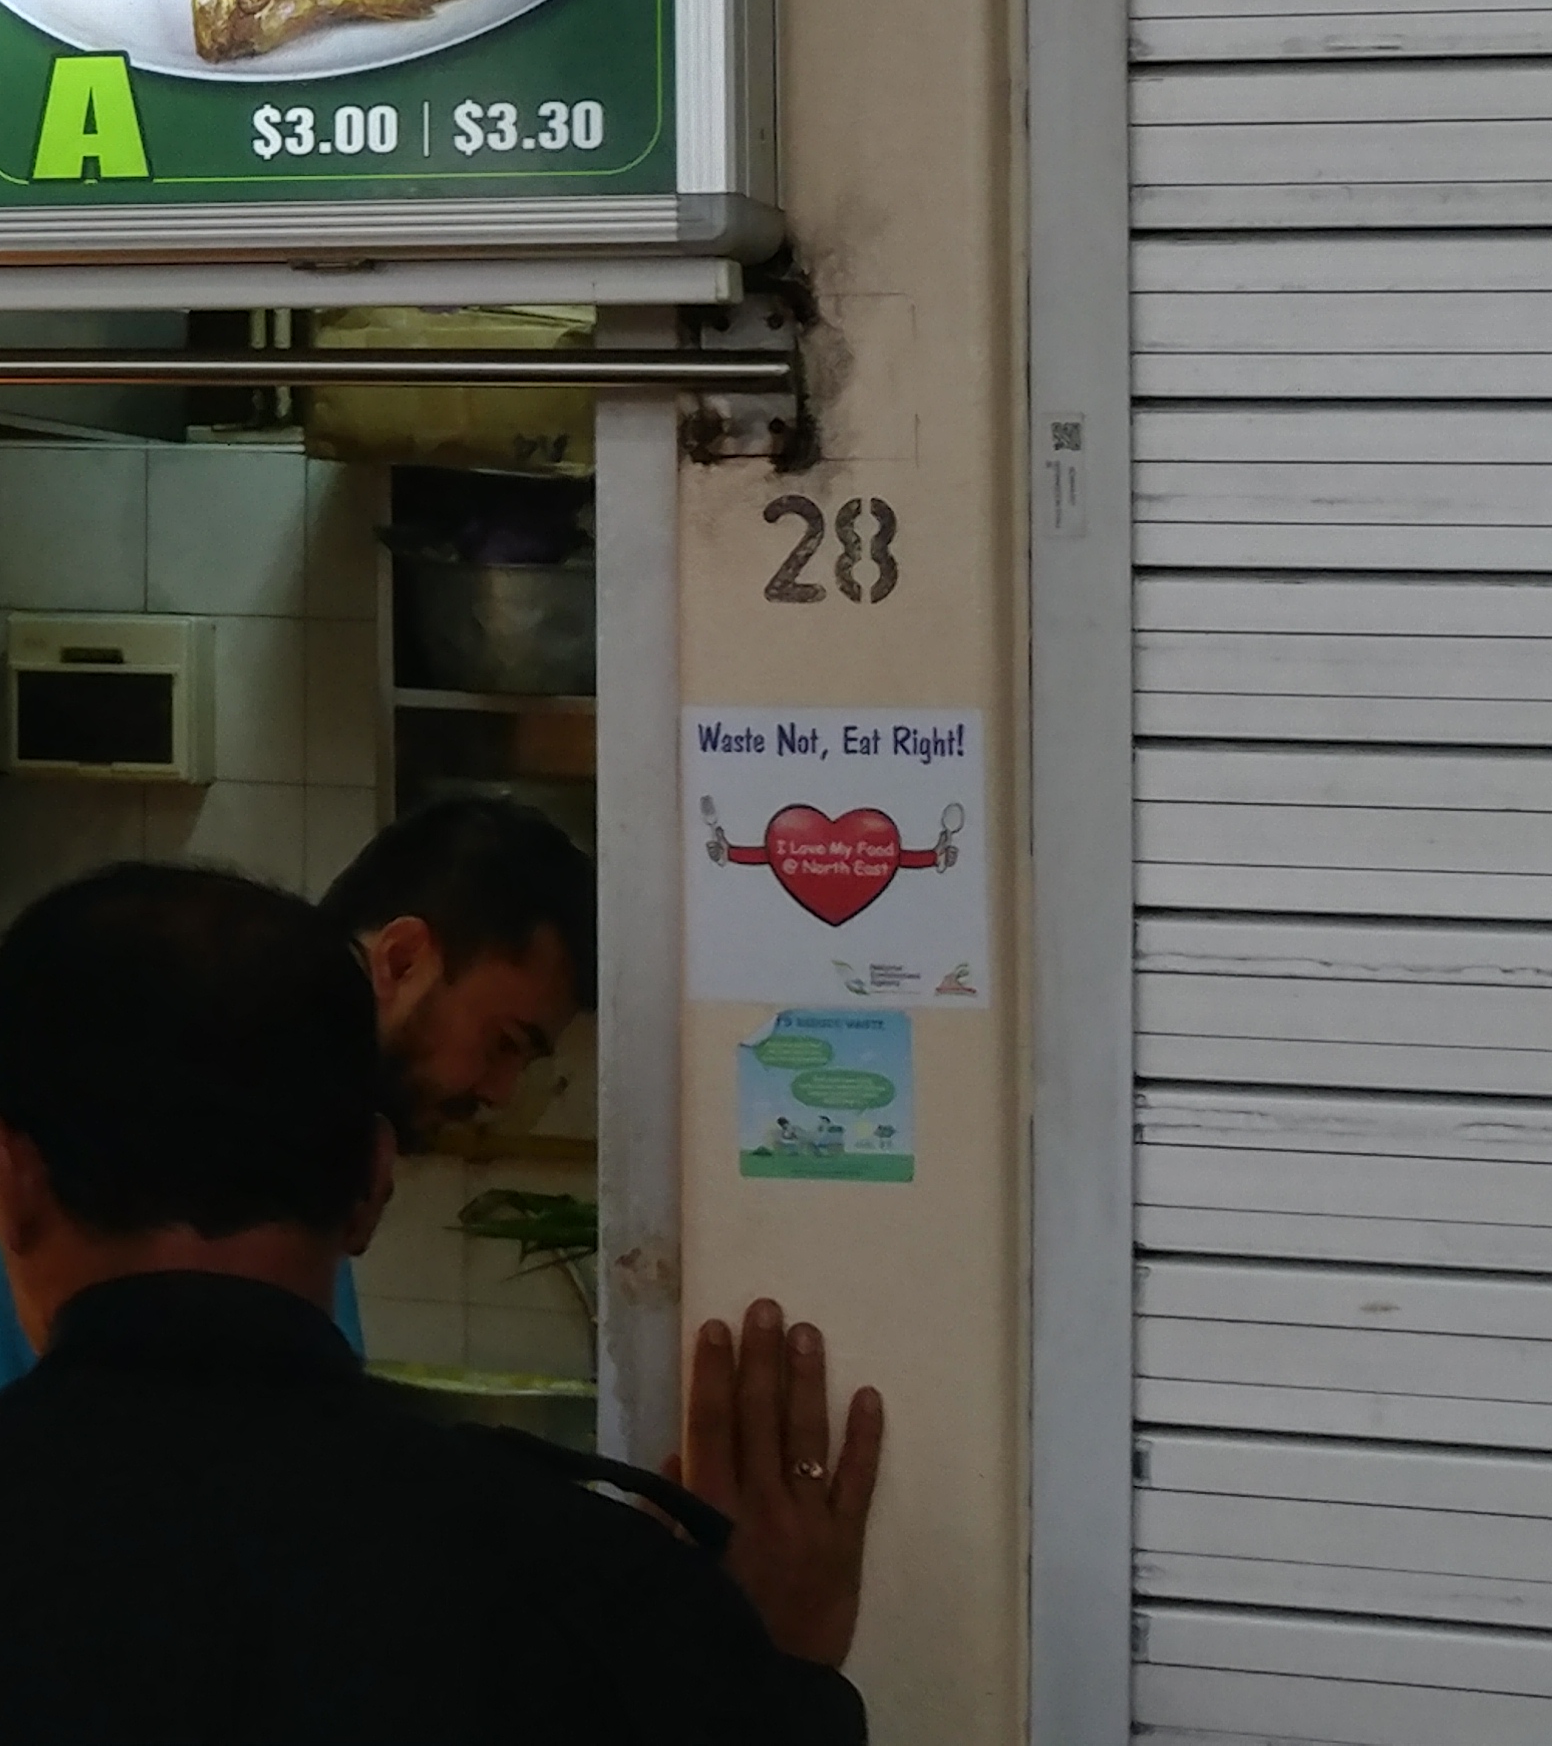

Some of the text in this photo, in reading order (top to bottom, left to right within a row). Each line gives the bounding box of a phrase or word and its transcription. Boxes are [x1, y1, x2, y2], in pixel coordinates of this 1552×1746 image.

[27, 50, 605, 184] A $3.00 $3.30
[762, 494, 900, 605] 28
[697, 721, 966, 765] Waste Not, Eat Right!
[790, 840, 827, 856] Love
[855, 841, 895, 858] Food
[801, 859, 851, 876] North
[853, 859, 889, 877] East
